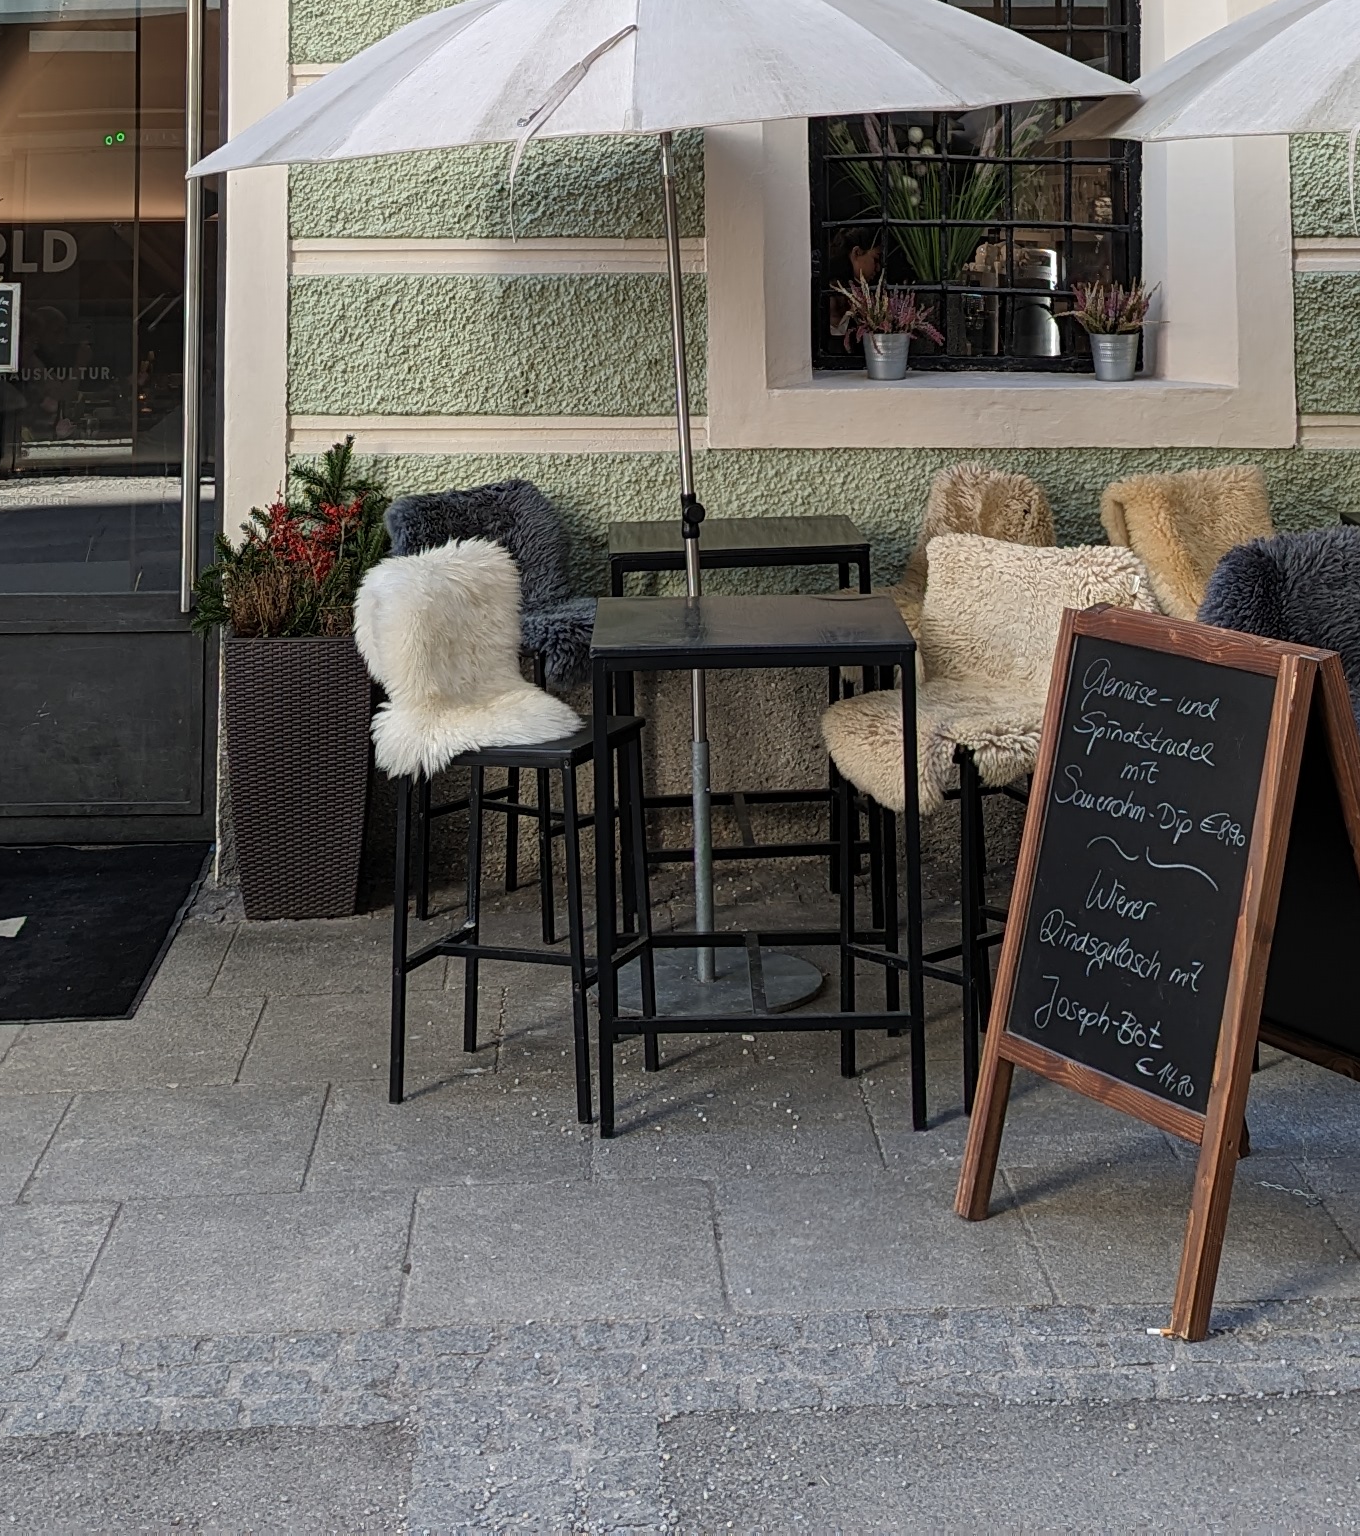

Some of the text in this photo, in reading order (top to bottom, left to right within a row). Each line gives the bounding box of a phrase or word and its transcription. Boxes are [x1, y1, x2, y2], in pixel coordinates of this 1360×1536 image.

[1177, 697, 1220, 721] und
[1073, 711, 1216, 766] Spinatstrudel
[1120, 761, 1160, 784] mit
[1086, 869, 1157, 920] Wiener
[1040, 908, 1205, 992] Rindsgulasch mit
